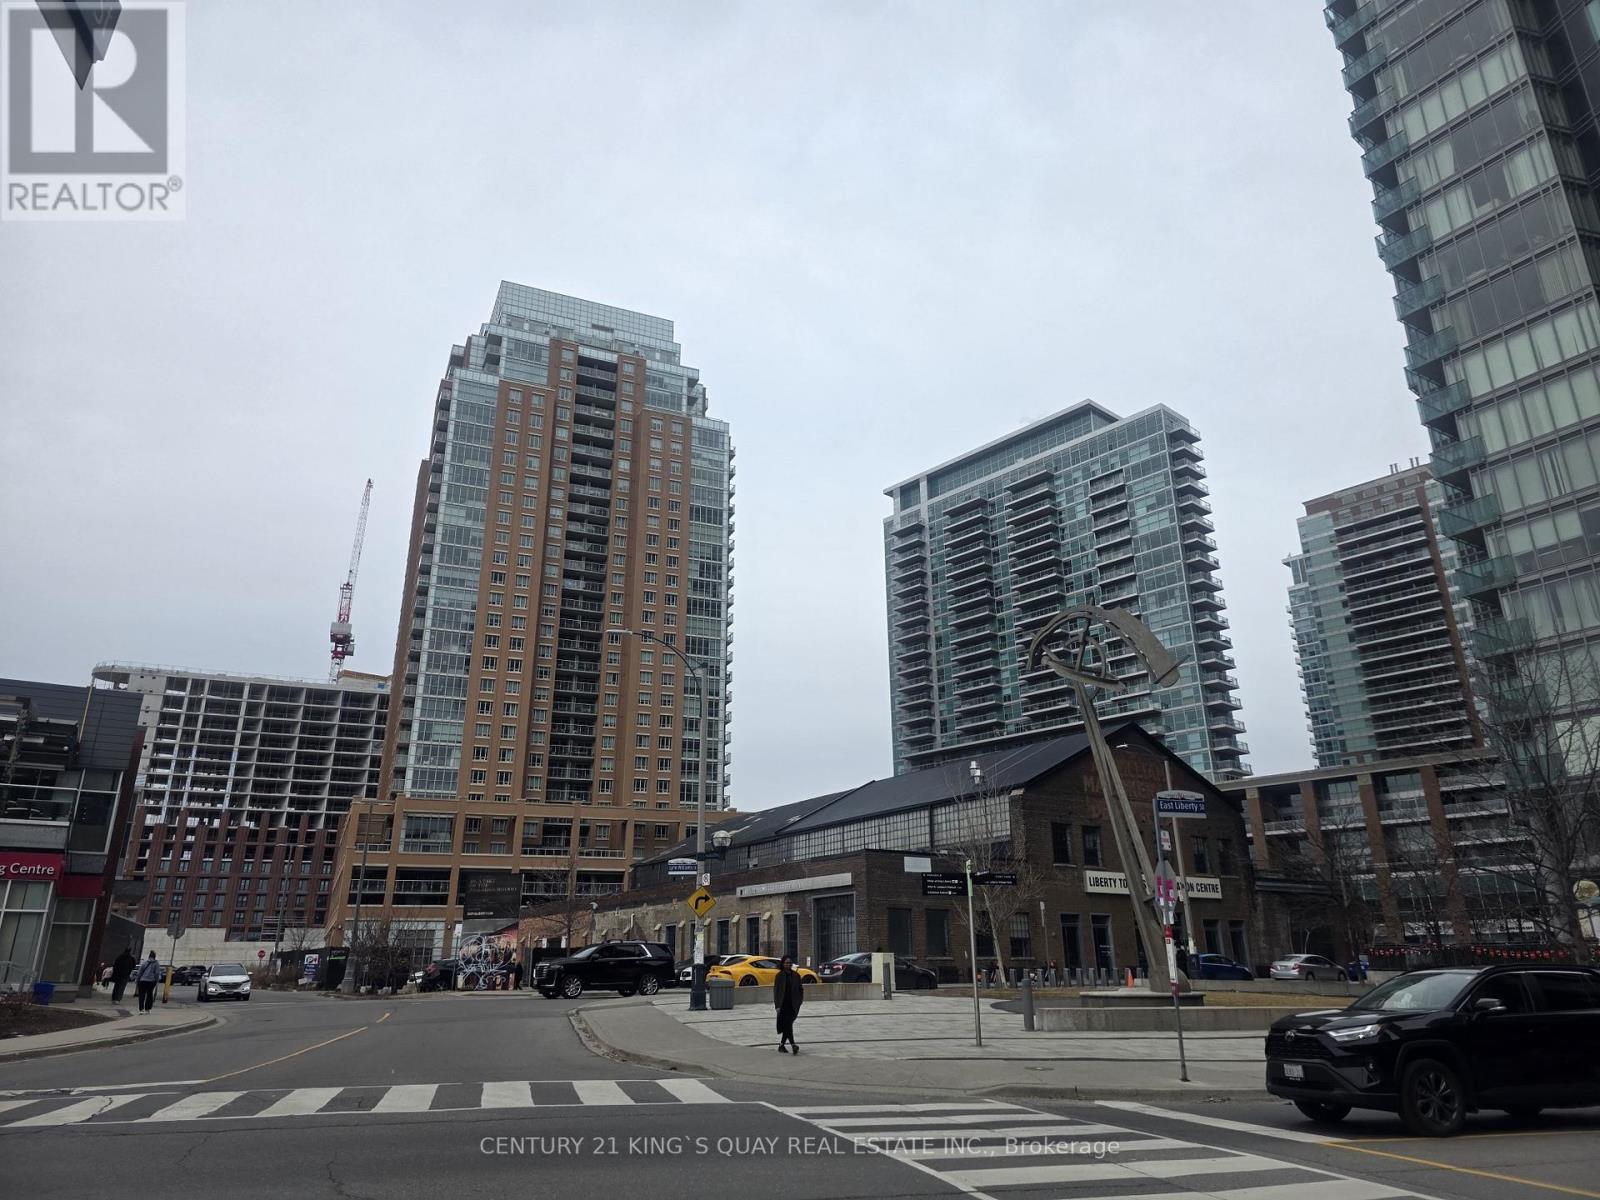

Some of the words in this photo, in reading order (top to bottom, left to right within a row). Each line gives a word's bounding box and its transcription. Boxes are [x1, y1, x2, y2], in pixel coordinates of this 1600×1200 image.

[1160, 800, 1175, 810] East
[1175, 801, 1198, 812] Liberty
[10, 862, 55, 875] Centre
[1088, 876, 1117, 888] LIBERTY
[1196, 882, 1220, 893] CENTRE
